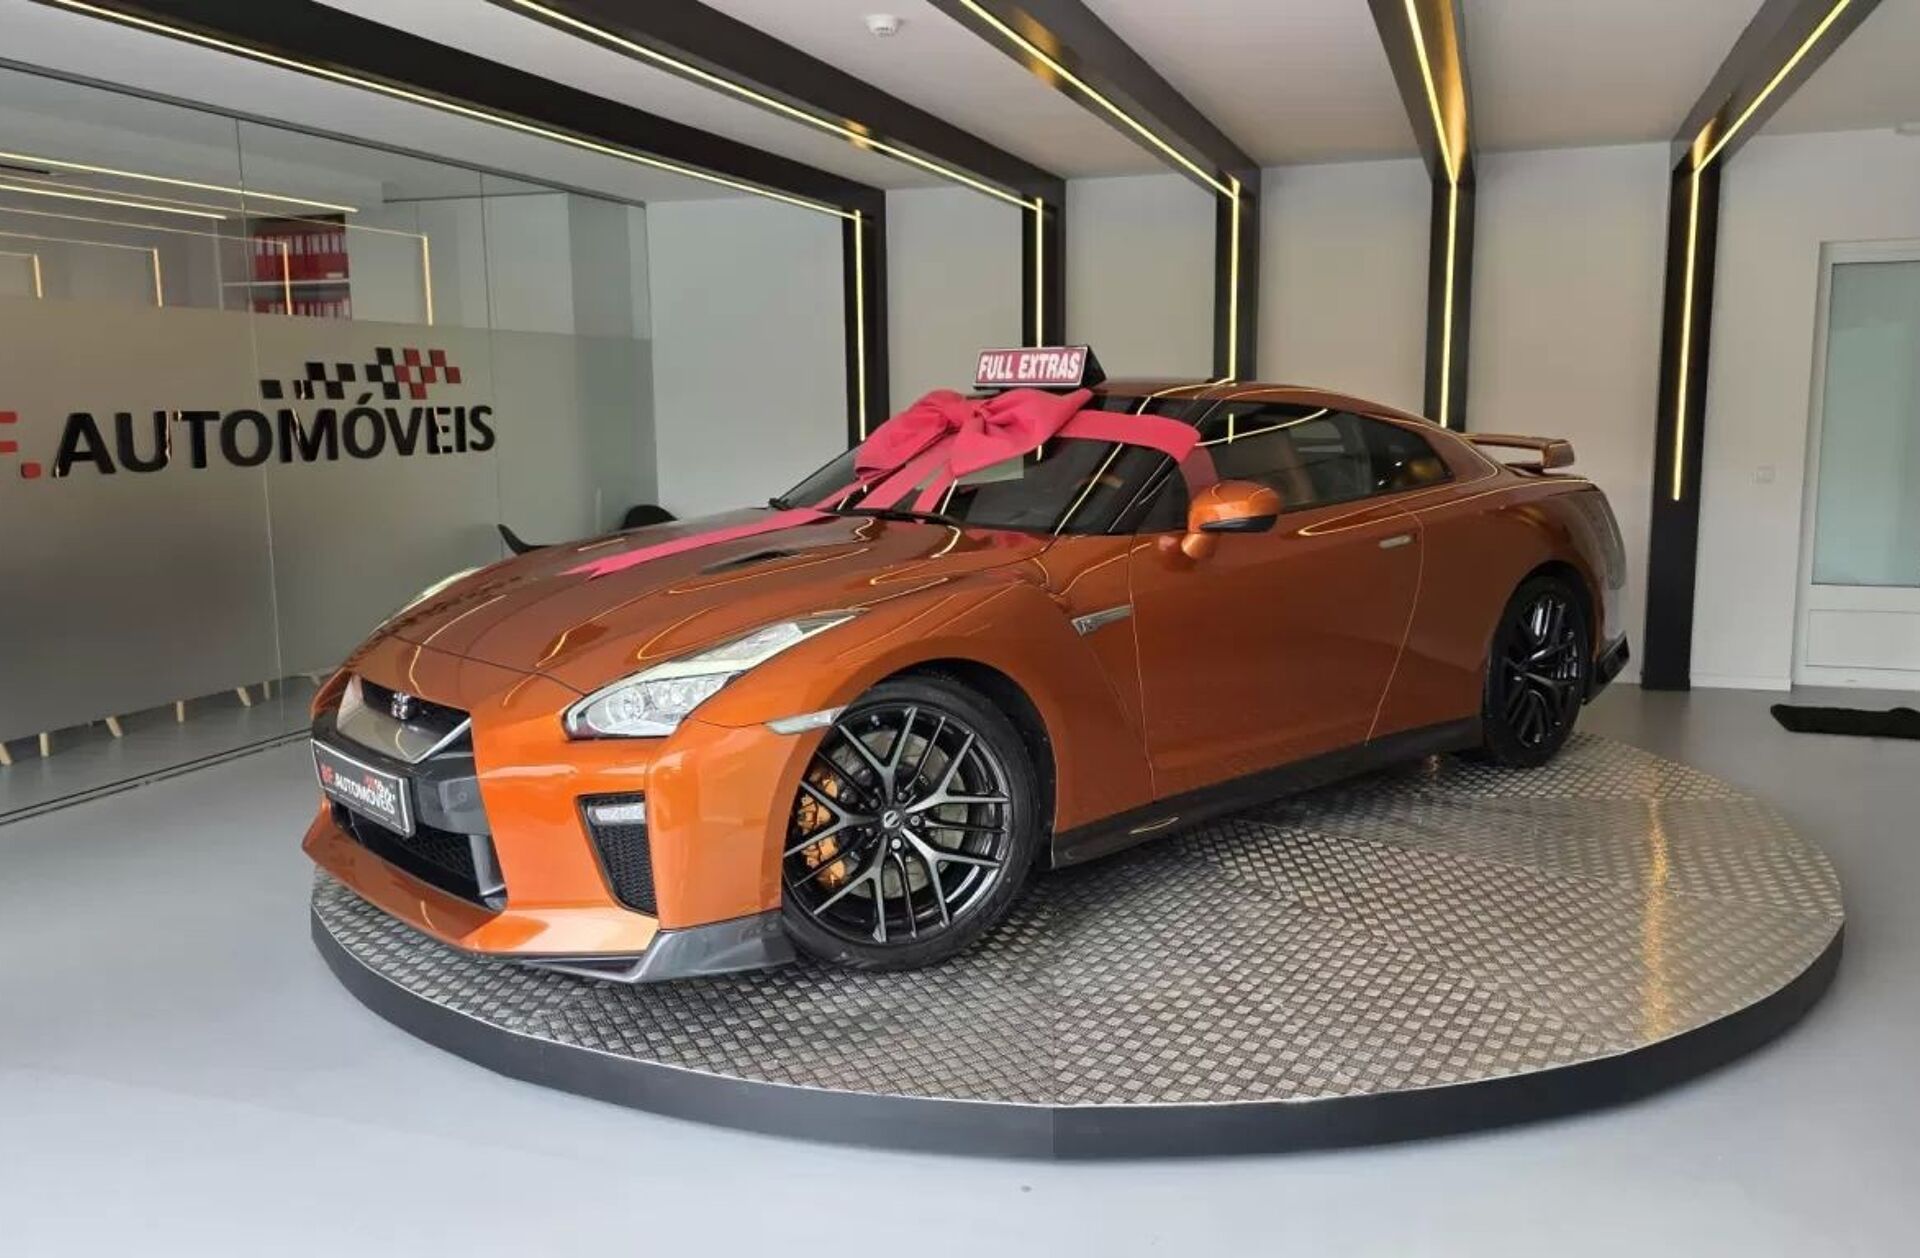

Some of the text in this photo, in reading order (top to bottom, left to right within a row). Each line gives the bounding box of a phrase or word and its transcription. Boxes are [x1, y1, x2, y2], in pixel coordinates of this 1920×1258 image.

[977, 352, 1080, 380] FULL EXTRAS
[52, 393, 496, 478] AUTOMÓVEIS
